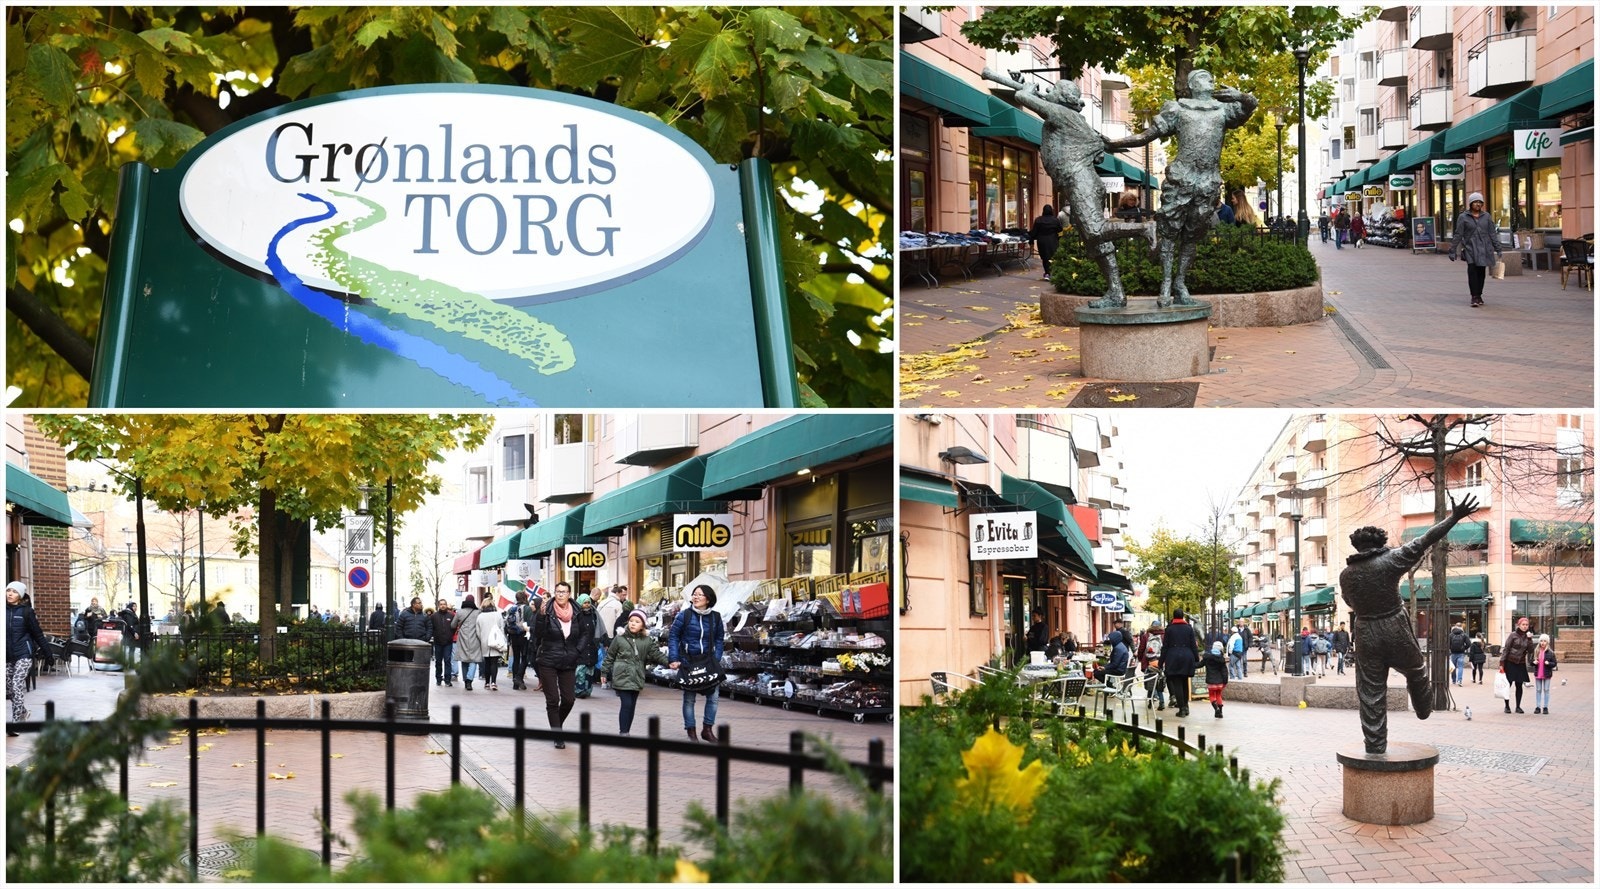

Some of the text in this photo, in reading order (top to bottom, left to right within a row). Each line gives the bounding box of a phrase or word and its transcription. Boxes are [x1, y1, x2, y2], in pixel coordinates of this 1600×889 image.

[1526, 130, 1553, 157] life
[265, 122, 617, 191] Grønlands
[1434, 165, 1461, 173] Specsavers
[1345, 192, 1361, 201] nille
[1365, 187, 1383, 197] nille
[404, 193, 621, 256] TORG
[677, 519, 729, 546] nille
[987, 519, 1019, 542] Evita
[568, 548, 604, 567] nille
[977, 544, 1030, 556] Espressobar
